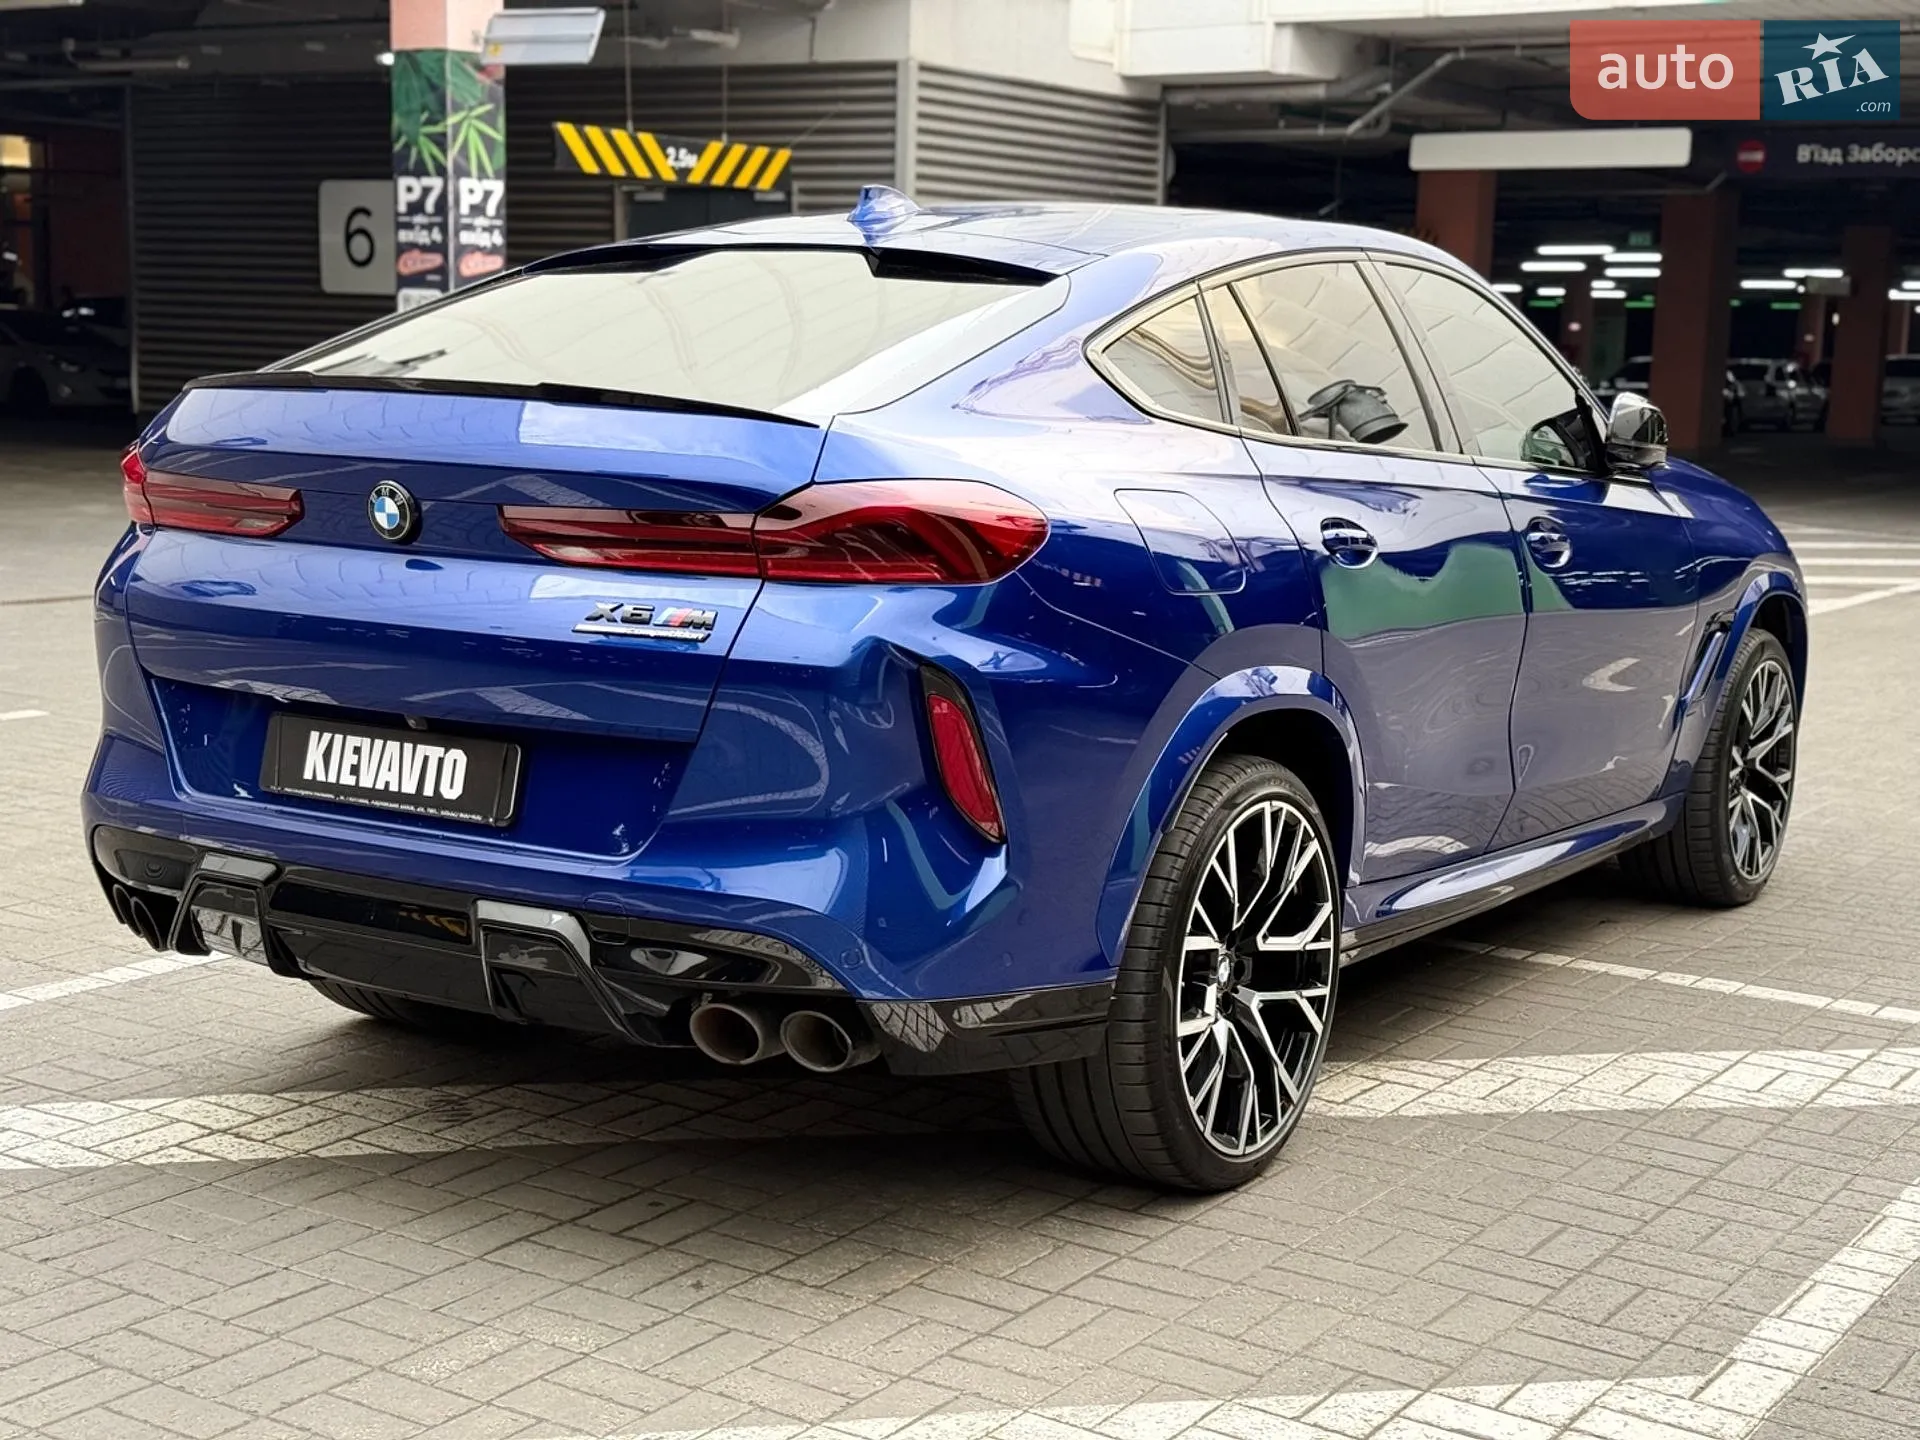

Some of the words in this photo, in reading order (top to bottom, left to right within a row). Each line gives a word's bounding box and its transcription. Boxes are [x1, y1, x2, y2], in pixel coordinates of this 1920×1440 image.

[396, 176, 444, 214] P7
[459, 177, 505, 217] P7
[344, 205, 376, 269] 6
[585, 602, 656, 625] X6
[302, 730, 468, 800] KIEVAVTO
